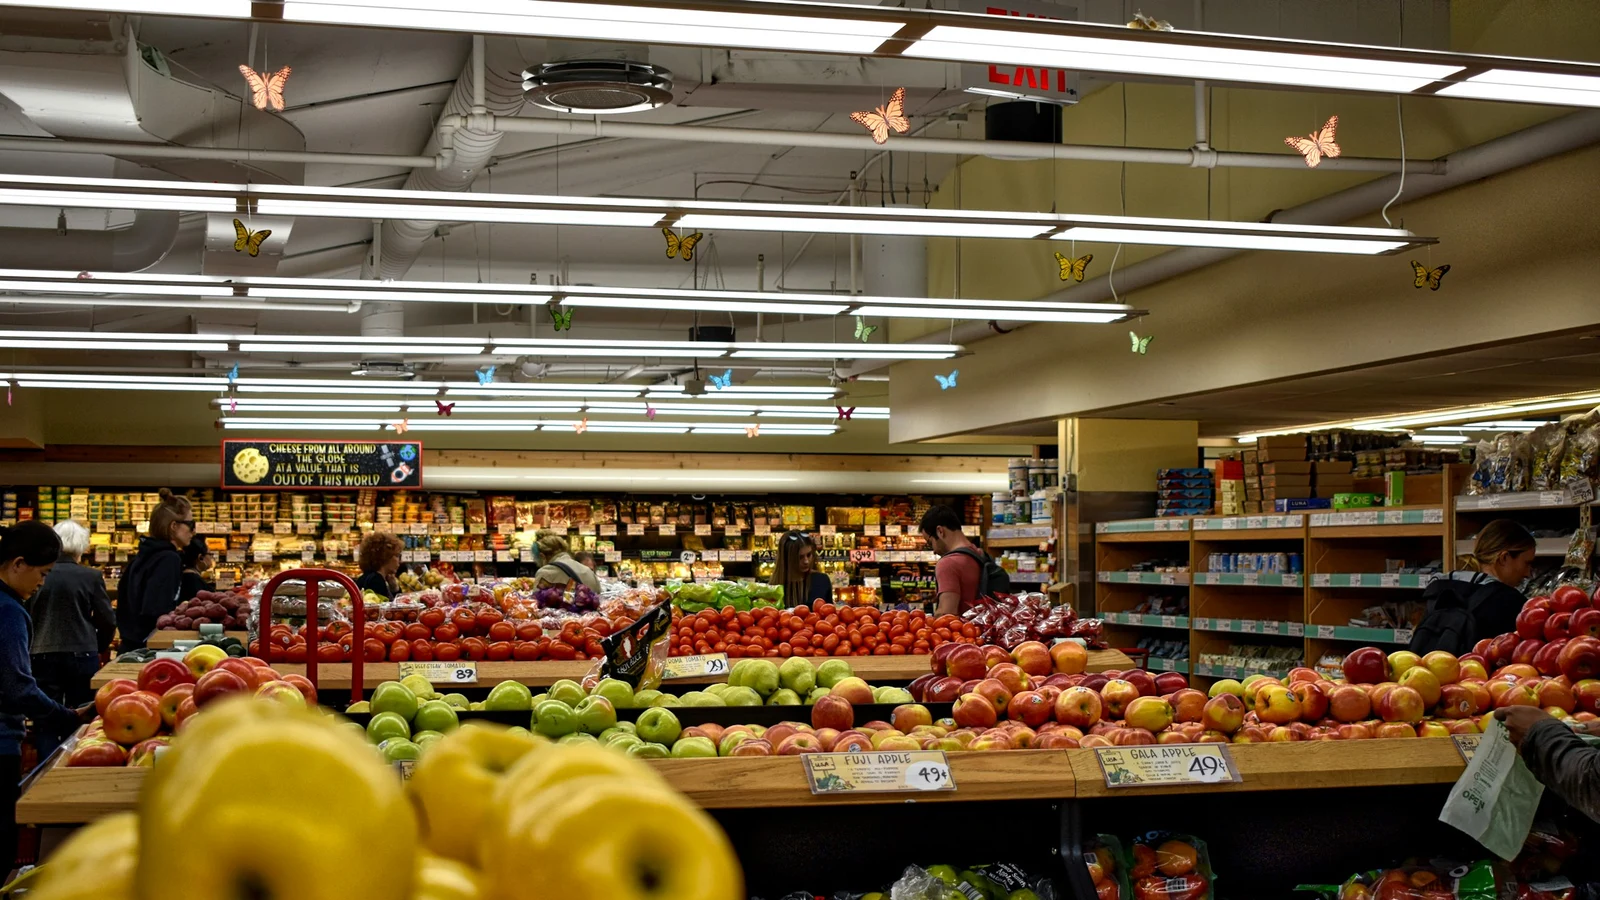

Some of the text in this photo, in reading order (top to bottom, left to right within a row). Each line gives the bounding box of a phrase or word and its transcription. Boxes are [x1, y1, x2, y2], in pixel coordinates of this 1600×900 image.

[269, 444, 376, 454] CHEESE FROM ALL AROUND
[296, 454, 346, 463] THE GLOBE
[296, 464, 322, 473] VALUE
[326, 464, 347, 472] THAT
[350, 464, 359, 472] IS
[272, 474, 380, 486] OUT OF THIS WORLD
[1351, 496, 1370, 505] ONE
[1130, 746, 1196, 760] GALA APPLE
[844, 753, 912, 766] FUJI APPLE
[1462, 790, 1486, 810] OPEN
